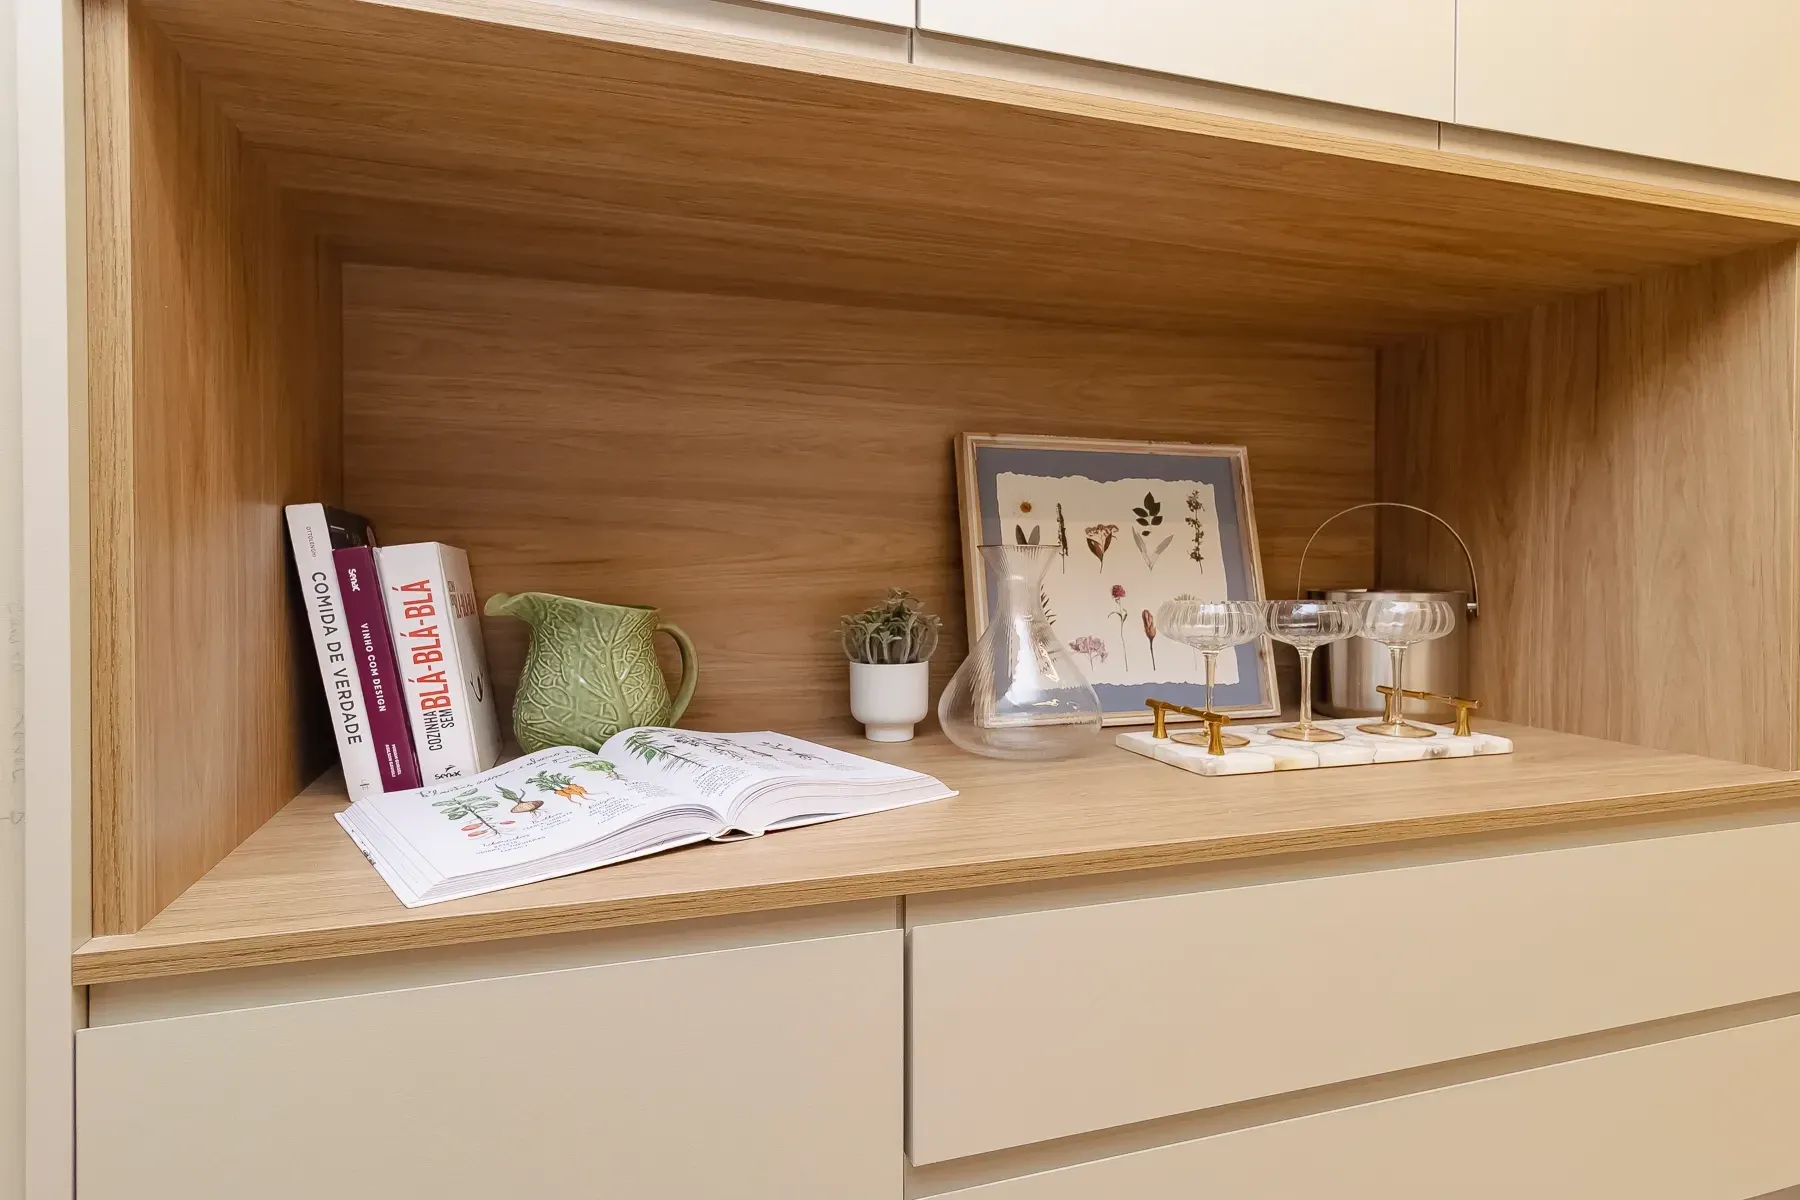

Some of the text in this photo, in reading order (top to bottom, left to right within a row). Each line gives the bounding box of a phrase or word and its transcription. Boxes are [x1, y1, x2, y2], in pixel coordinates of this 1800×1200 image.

[305, 526, 317, 558] OTTOLENGHI
[312, 572, 362, 745] COMIDA DE VERDADE
[361, 622, 387, 712] VINHO COM DESIGN
[423, 710, 442, 752] COZINHA
[439, 708, 454, 728] SEM
